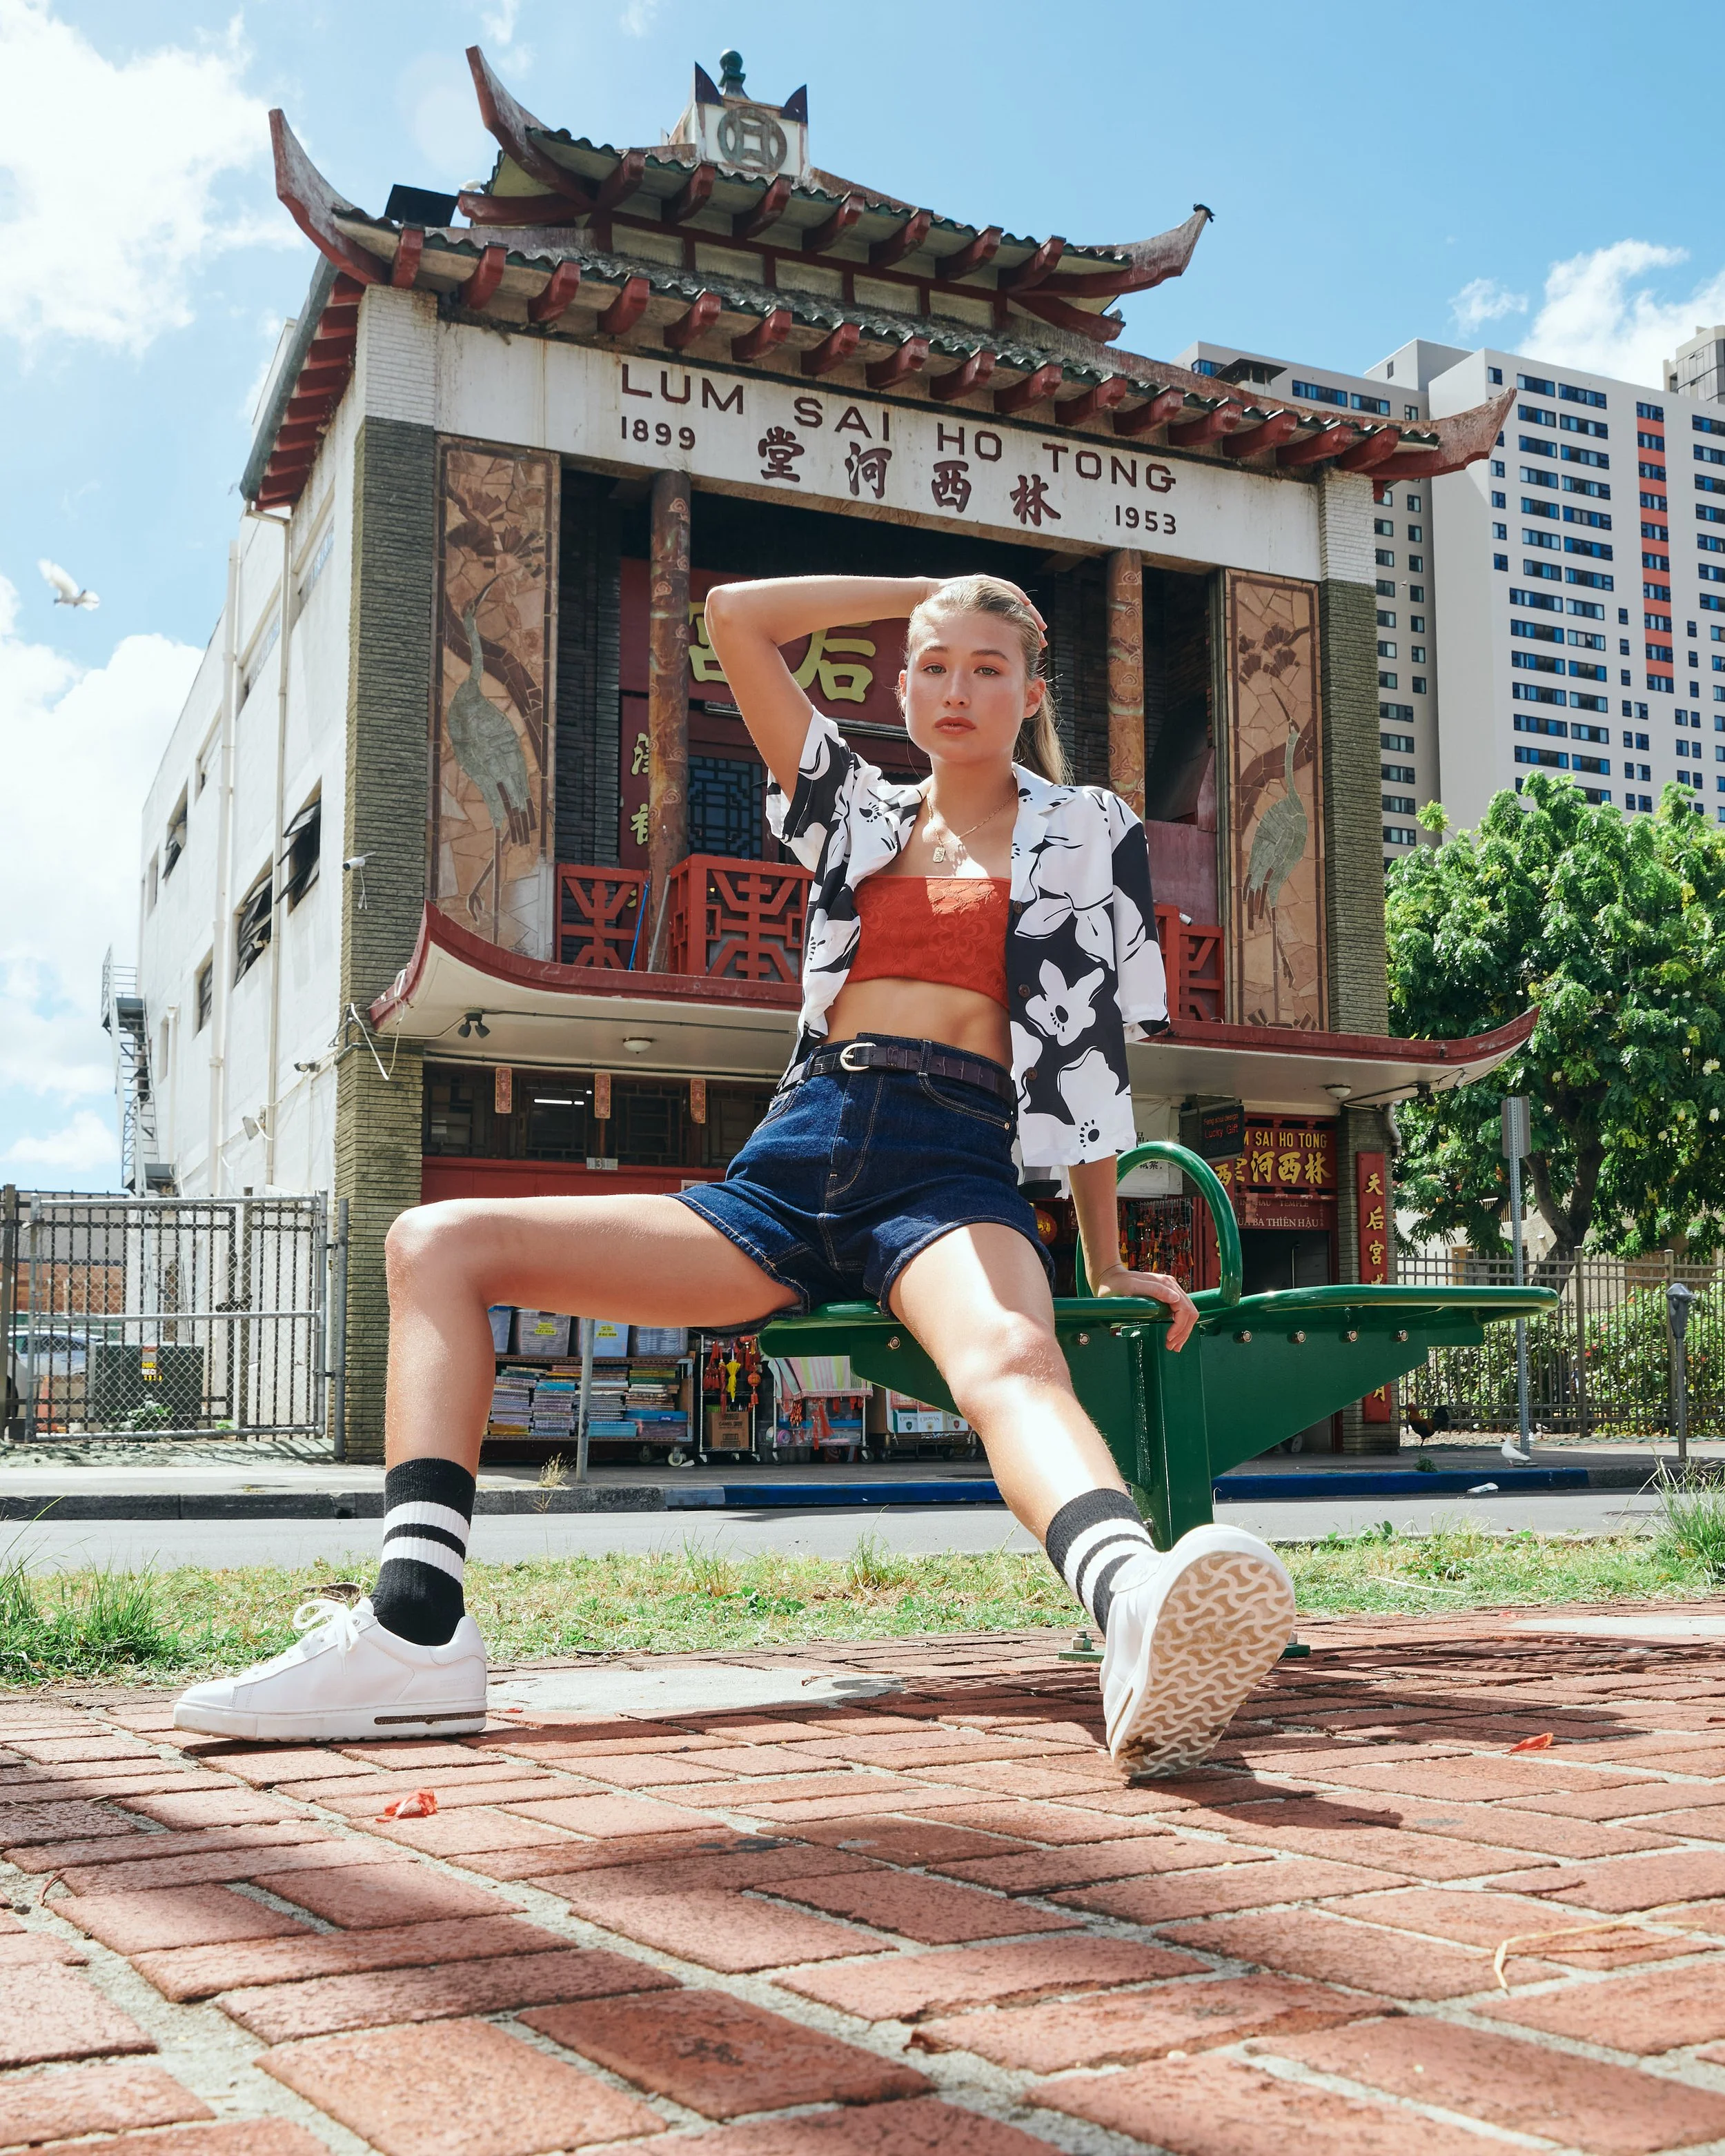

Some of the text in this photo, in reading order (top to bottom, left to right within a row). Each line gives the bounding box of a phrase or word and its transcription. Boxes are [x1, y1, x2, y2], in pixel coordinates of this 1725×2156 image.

[621, 415, 696, 451] 1899
[622, 363, 1176, 493] LUM SAI HO TONG
[1115, 504, 1177, 535] 1953
[1255, 1131, 1273, 1147] SAI
[1279, 1132, 1294, 1147] HO
[1299, 1133, 1328, 1149] TONG
